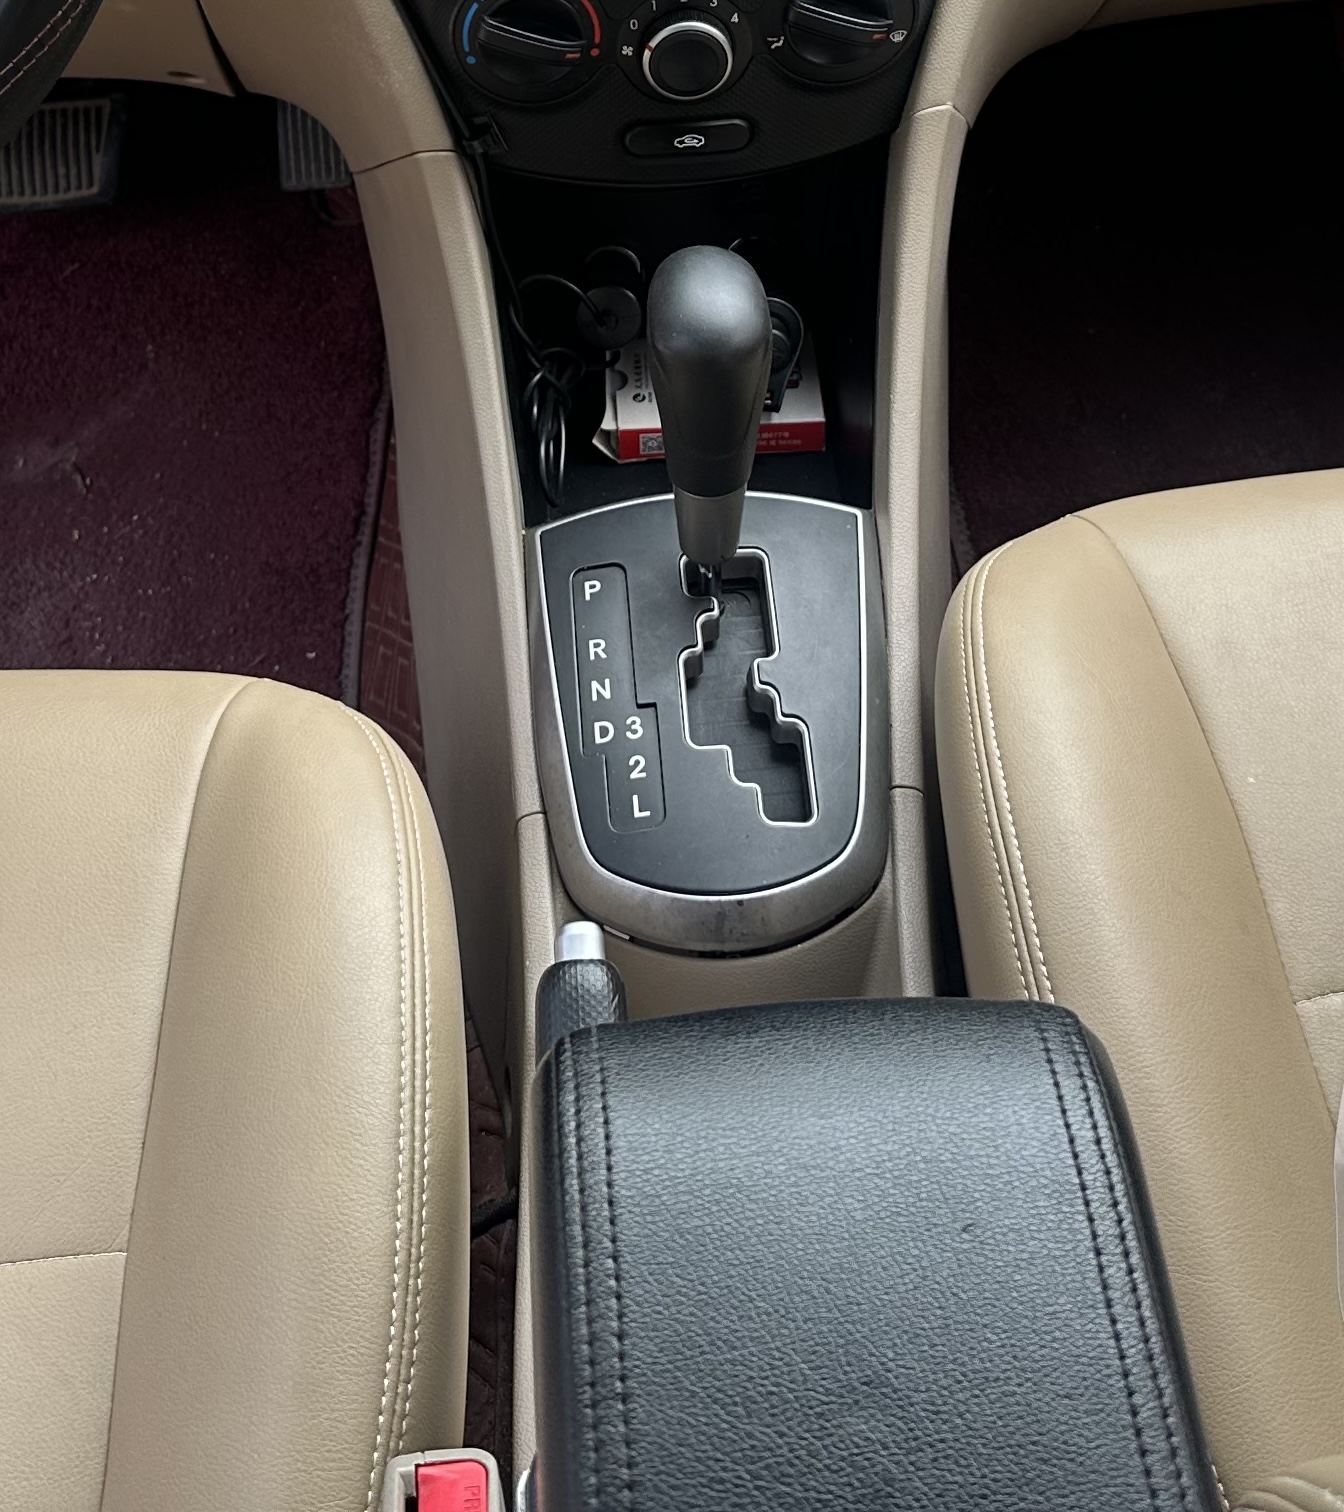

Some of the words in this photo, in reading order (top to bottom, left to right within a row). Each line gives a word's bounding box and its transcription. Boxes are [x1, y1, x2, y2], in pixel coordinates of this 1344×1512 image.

[651, 0, 657, 11] 1
[629, 18, 639, 30] 0
[730, 12, 740, 24] 4
[583, 579, 602, 602] P
[588, 638, 608, 661] R
[591, 677, 612, 702] N
[593, 720, 615, 744] D
[625, 715, 644, 740] 3
[628, 754, 647, 780] 2
[632, 794, 651, 819] L
